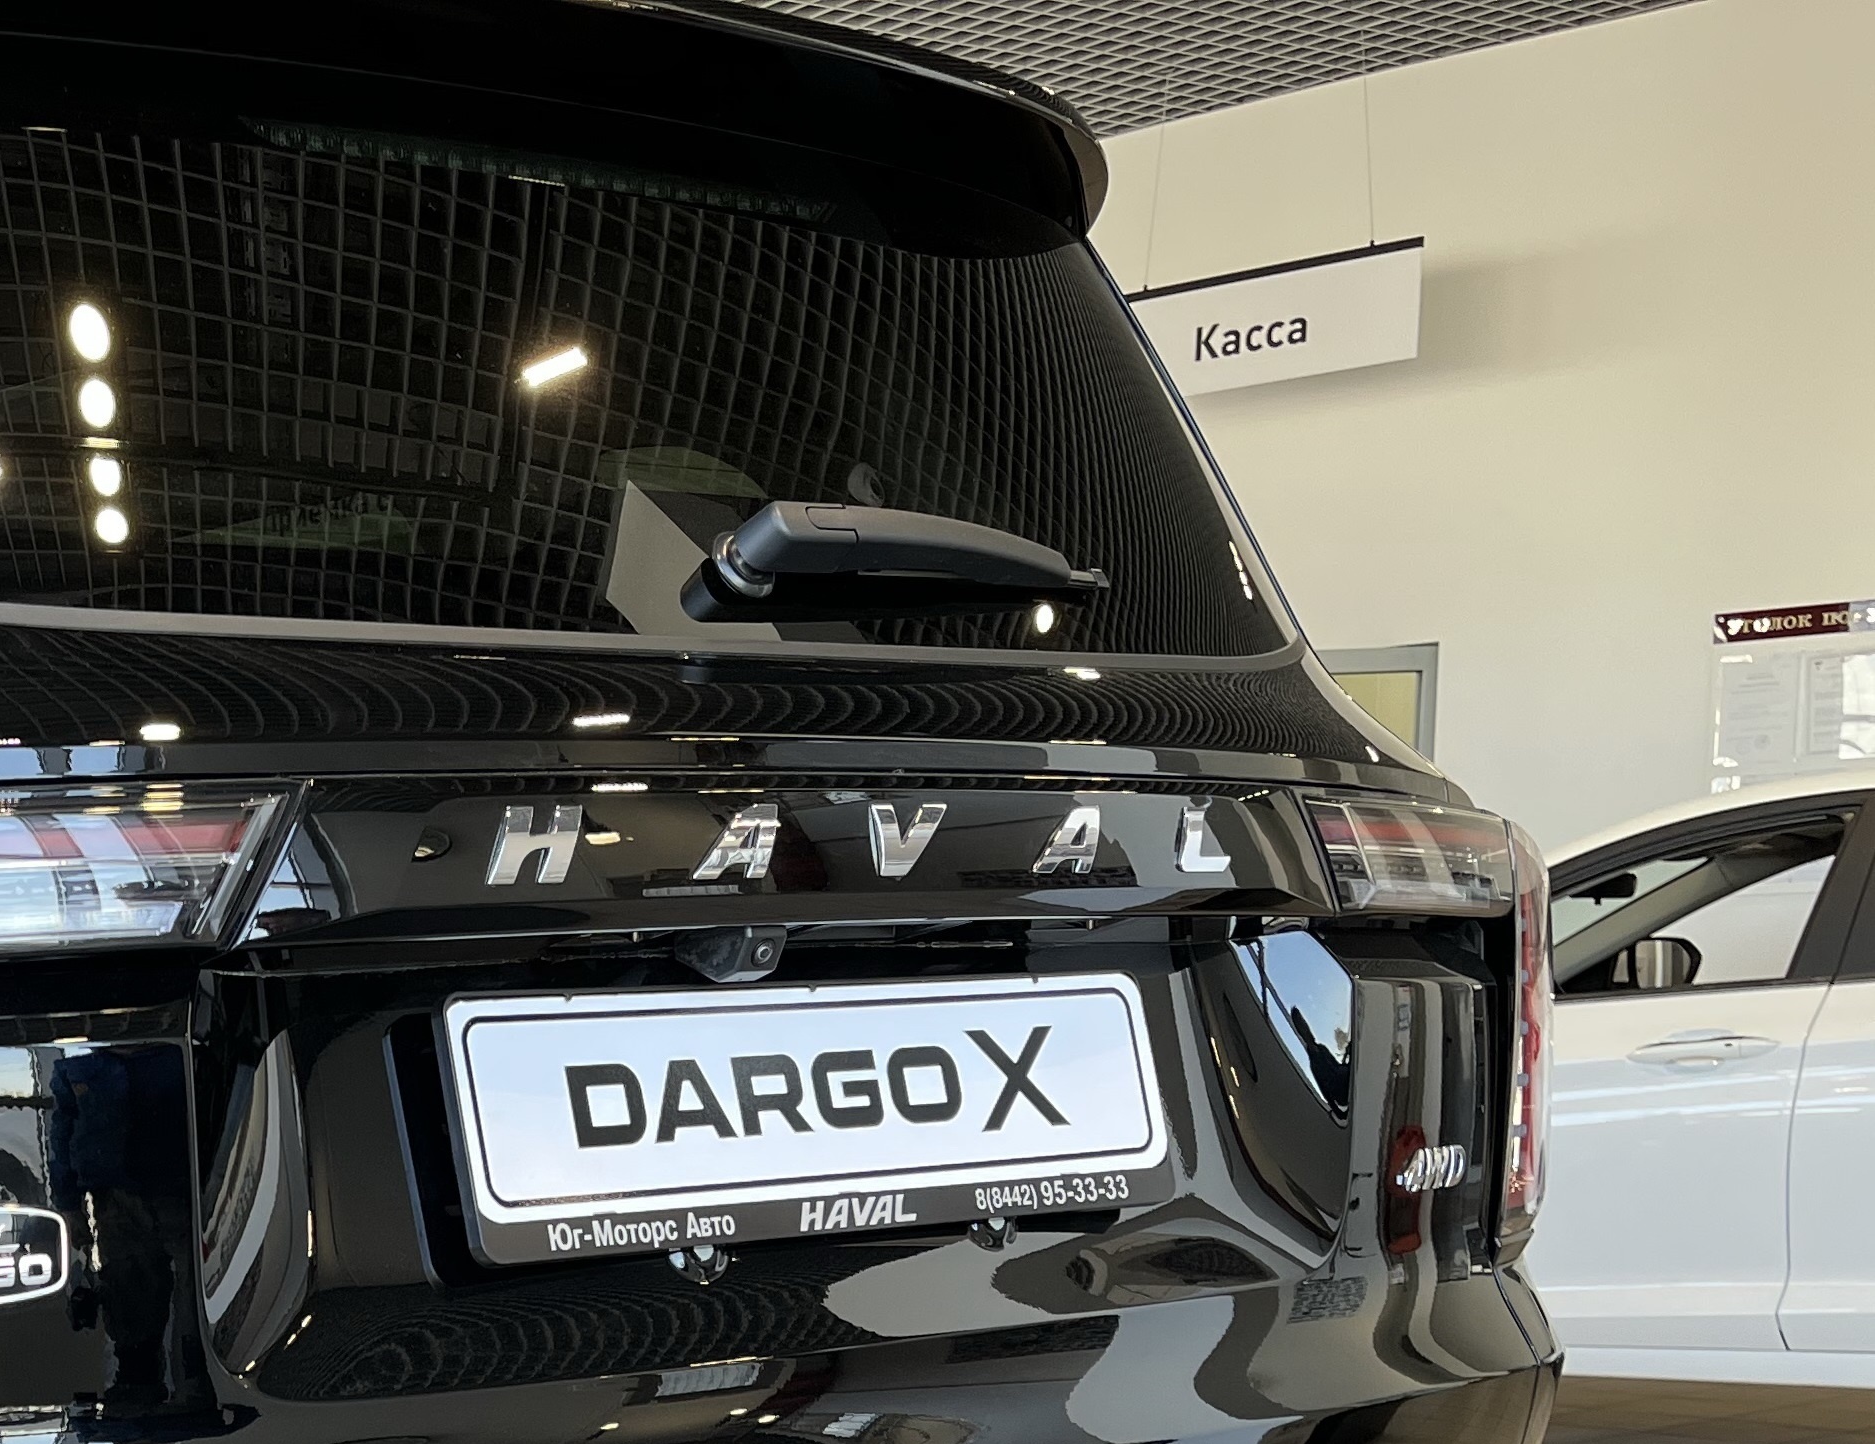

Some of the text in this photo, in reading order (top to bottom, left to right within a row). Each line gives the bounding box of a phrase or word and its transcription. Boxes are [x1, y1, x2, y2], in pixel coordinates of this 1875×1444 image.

[1194, 316, 1308, 362] Касса
[485, 802, 1232, 887] HAVAL
[799, 1194, 918, 1233] HAVAL
[974, 1174, 1130, 1214] 8(8442) 95-33-33
[547, 1211, 736, 1252] Юг-Моторс Авто
